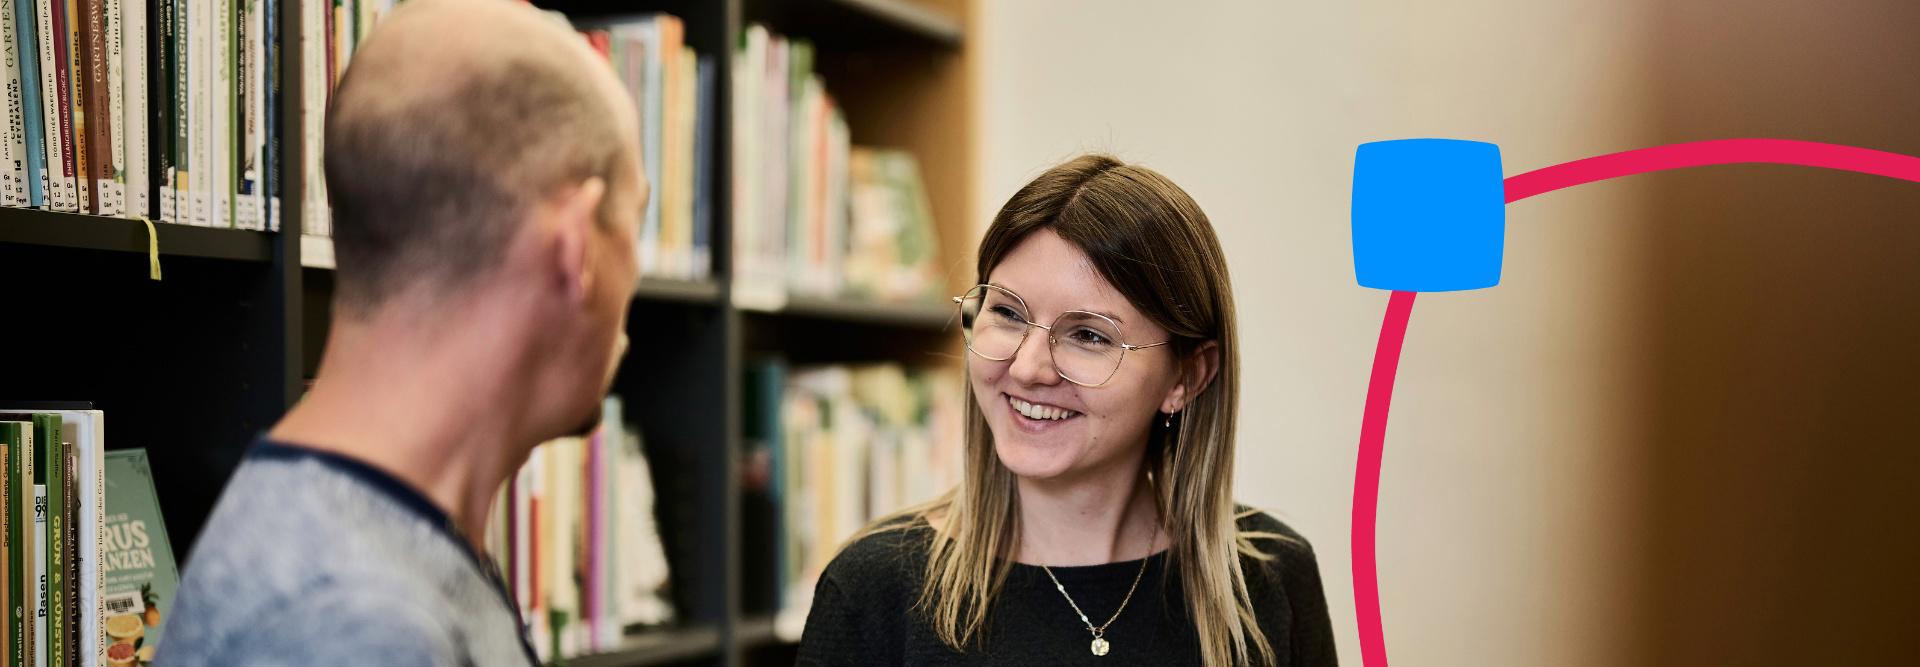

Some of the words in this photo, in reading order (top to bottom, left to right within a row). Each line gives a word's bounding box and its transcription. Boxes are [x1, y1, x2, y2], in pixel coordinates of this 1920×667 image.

[12, 78, 22, 144] FEYERABEND
[53, 515, 62, 566] GRÜN
[105, 520, 149, 552] RUS
[38, 574, 47, 618] Rasen
[54, 572, 62, 584] &
